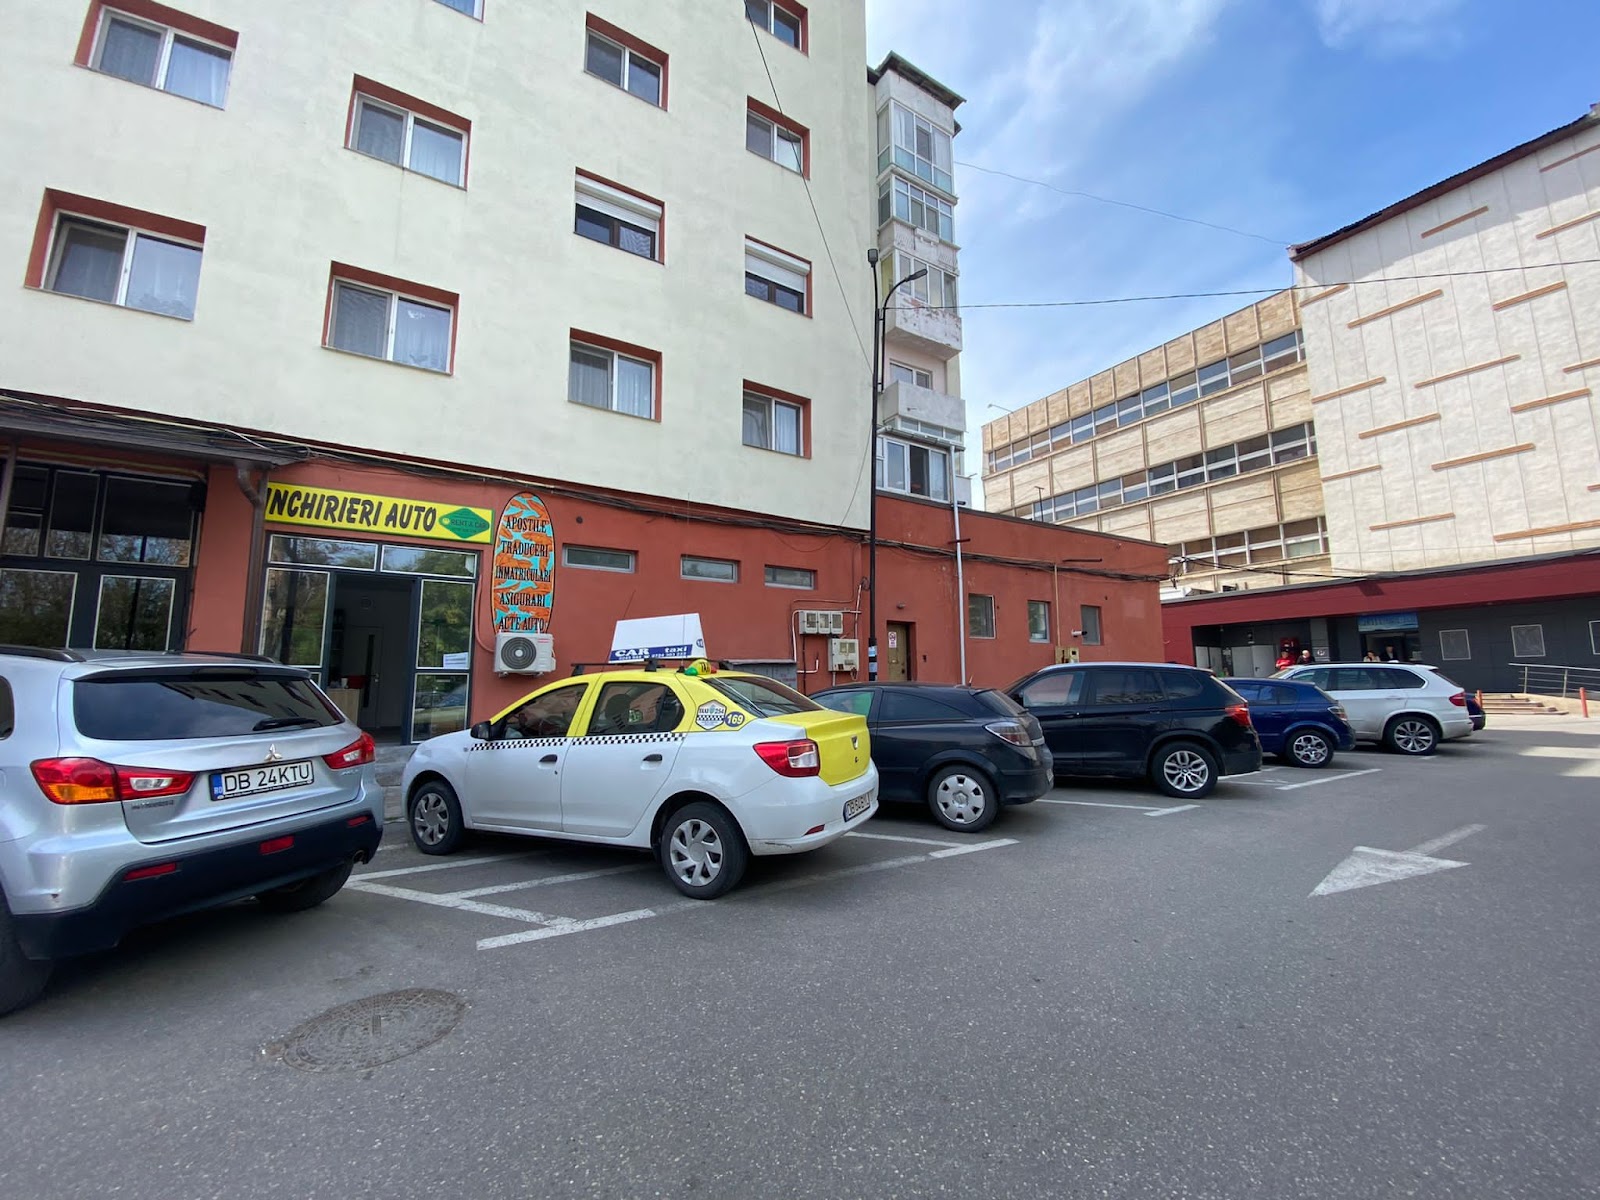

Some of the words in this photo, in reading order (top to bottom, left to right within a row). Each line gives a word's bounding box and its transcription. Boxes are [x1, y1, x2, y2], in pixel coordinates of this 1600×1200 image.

[384, 503, 437, 532] AUTO
[506, 516, 548, 533] APOSTILE
[501, 540, 548, 558] TRADUCERI
[495, 565, 551, 583] INMATRICULARI
[499, 591, 546, 607] ASIGURARI
[499, 616, 521, 631] ACTE
[522, 617, 546, 633] AUTO
[614, 647, 650, 658] CAR
[664, 645, 688, 654] taxi
[727, 714, 744, 726] 169
[224, 773, 251, 793] DB
[257, 763, 310, 788] 24KTU
[213, 786, 223, 795] RO
